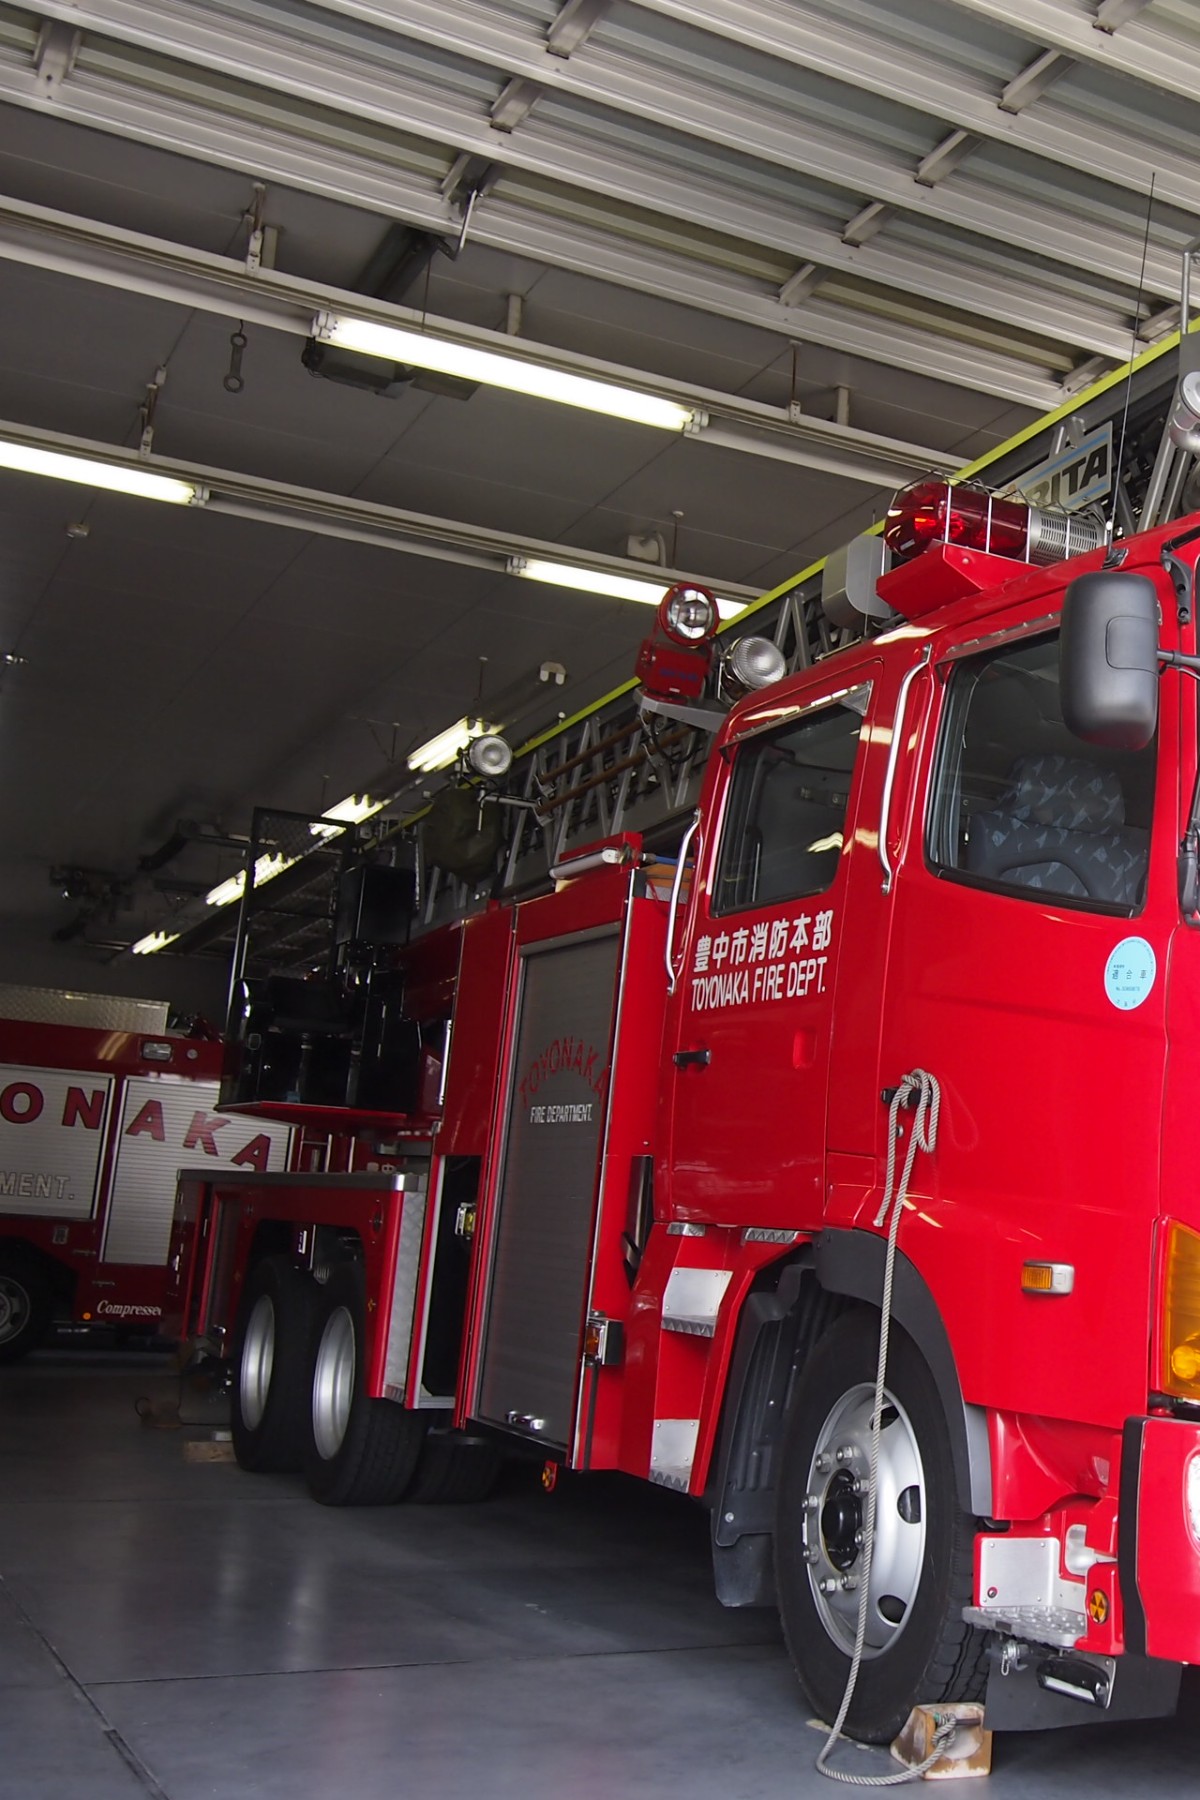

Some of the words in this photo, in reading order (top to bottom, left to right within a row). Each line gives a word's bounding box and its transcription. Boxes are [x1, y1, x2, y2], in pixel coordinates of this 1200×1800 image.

[692, 909, 834, 973] 豊中市消防本部
[691, 970, 749, 1012] TOYONAKA
[752, 963, 786, 1003] FIRE
[787, 956, 828, 998] DEPT.
[518, 1036, 610, 1109] TOYONAKA
